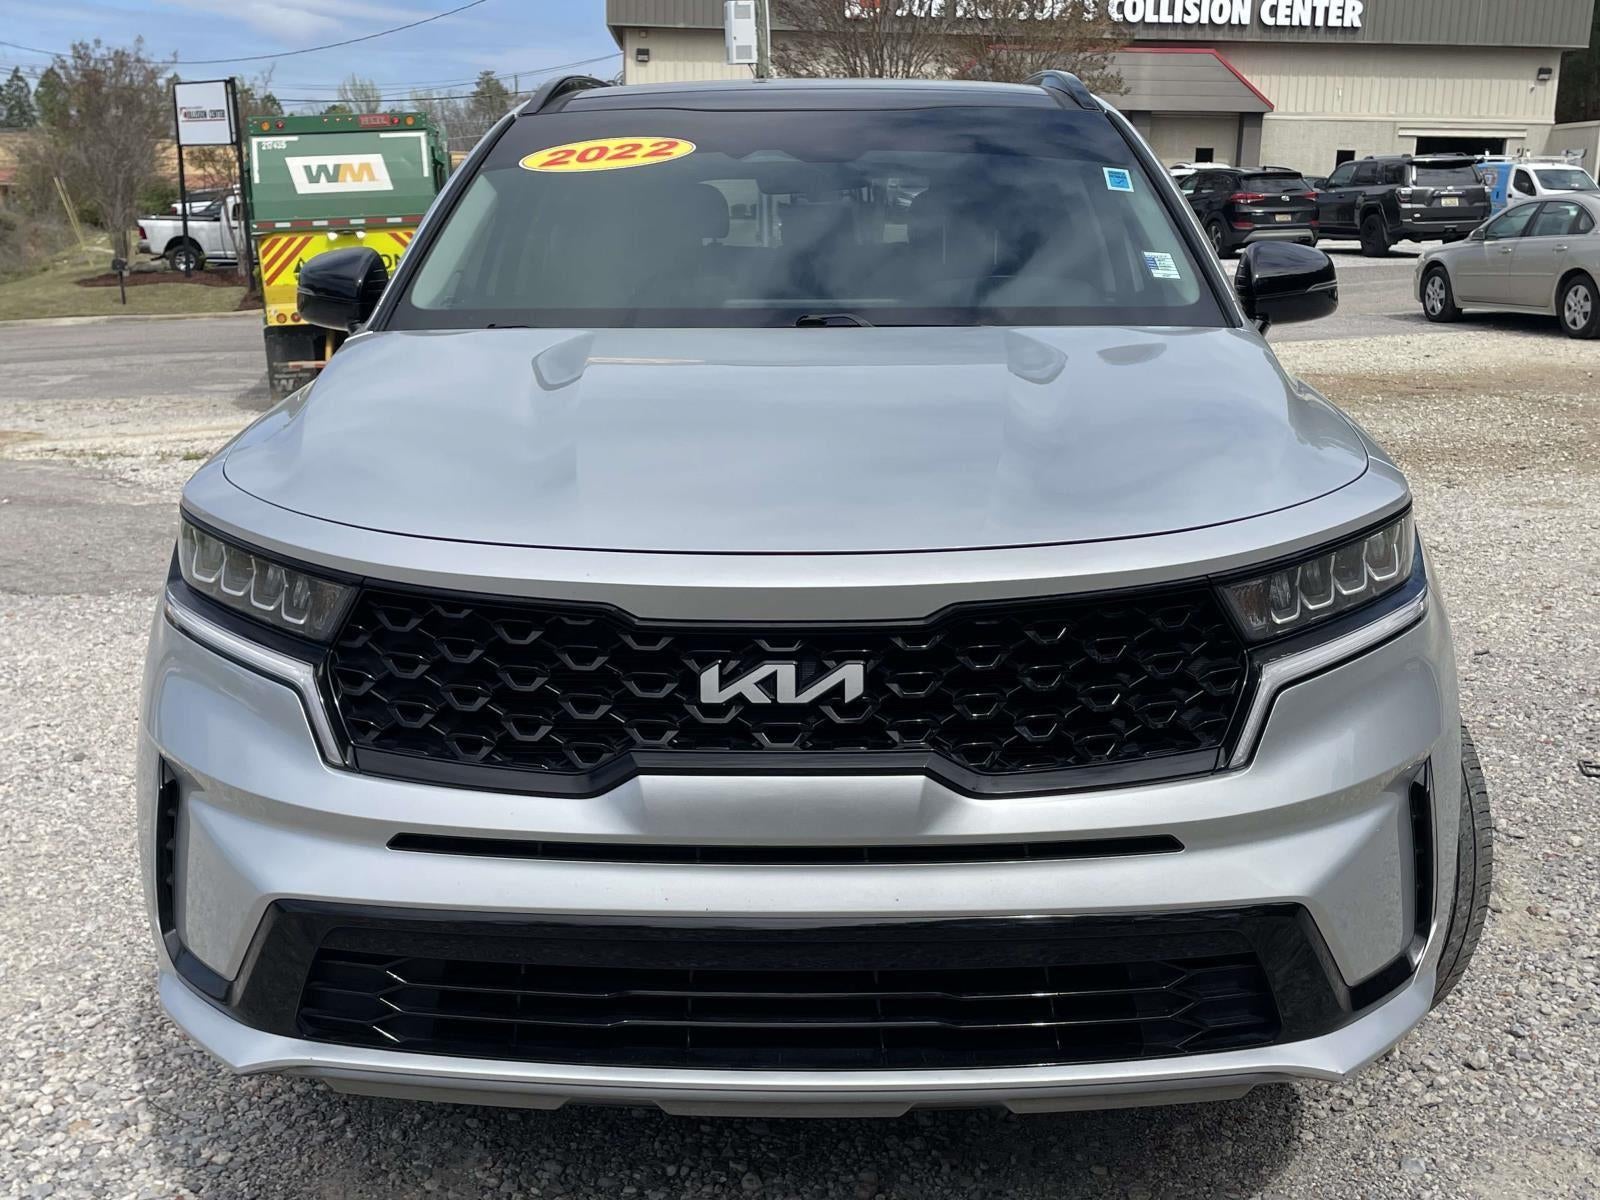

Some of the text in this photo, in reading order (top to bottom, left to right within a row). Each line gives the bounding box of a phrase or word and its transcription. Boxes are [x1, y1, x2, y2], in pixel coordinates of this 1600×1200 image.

[1107, 0, 1250, 25] COLLISION
[1259, 0, 1364, 28] CENTER
[538, 141, 679, 167] 2022
[303, 162, 379, 184] WM
[700, 661, 865, 704] KIA
